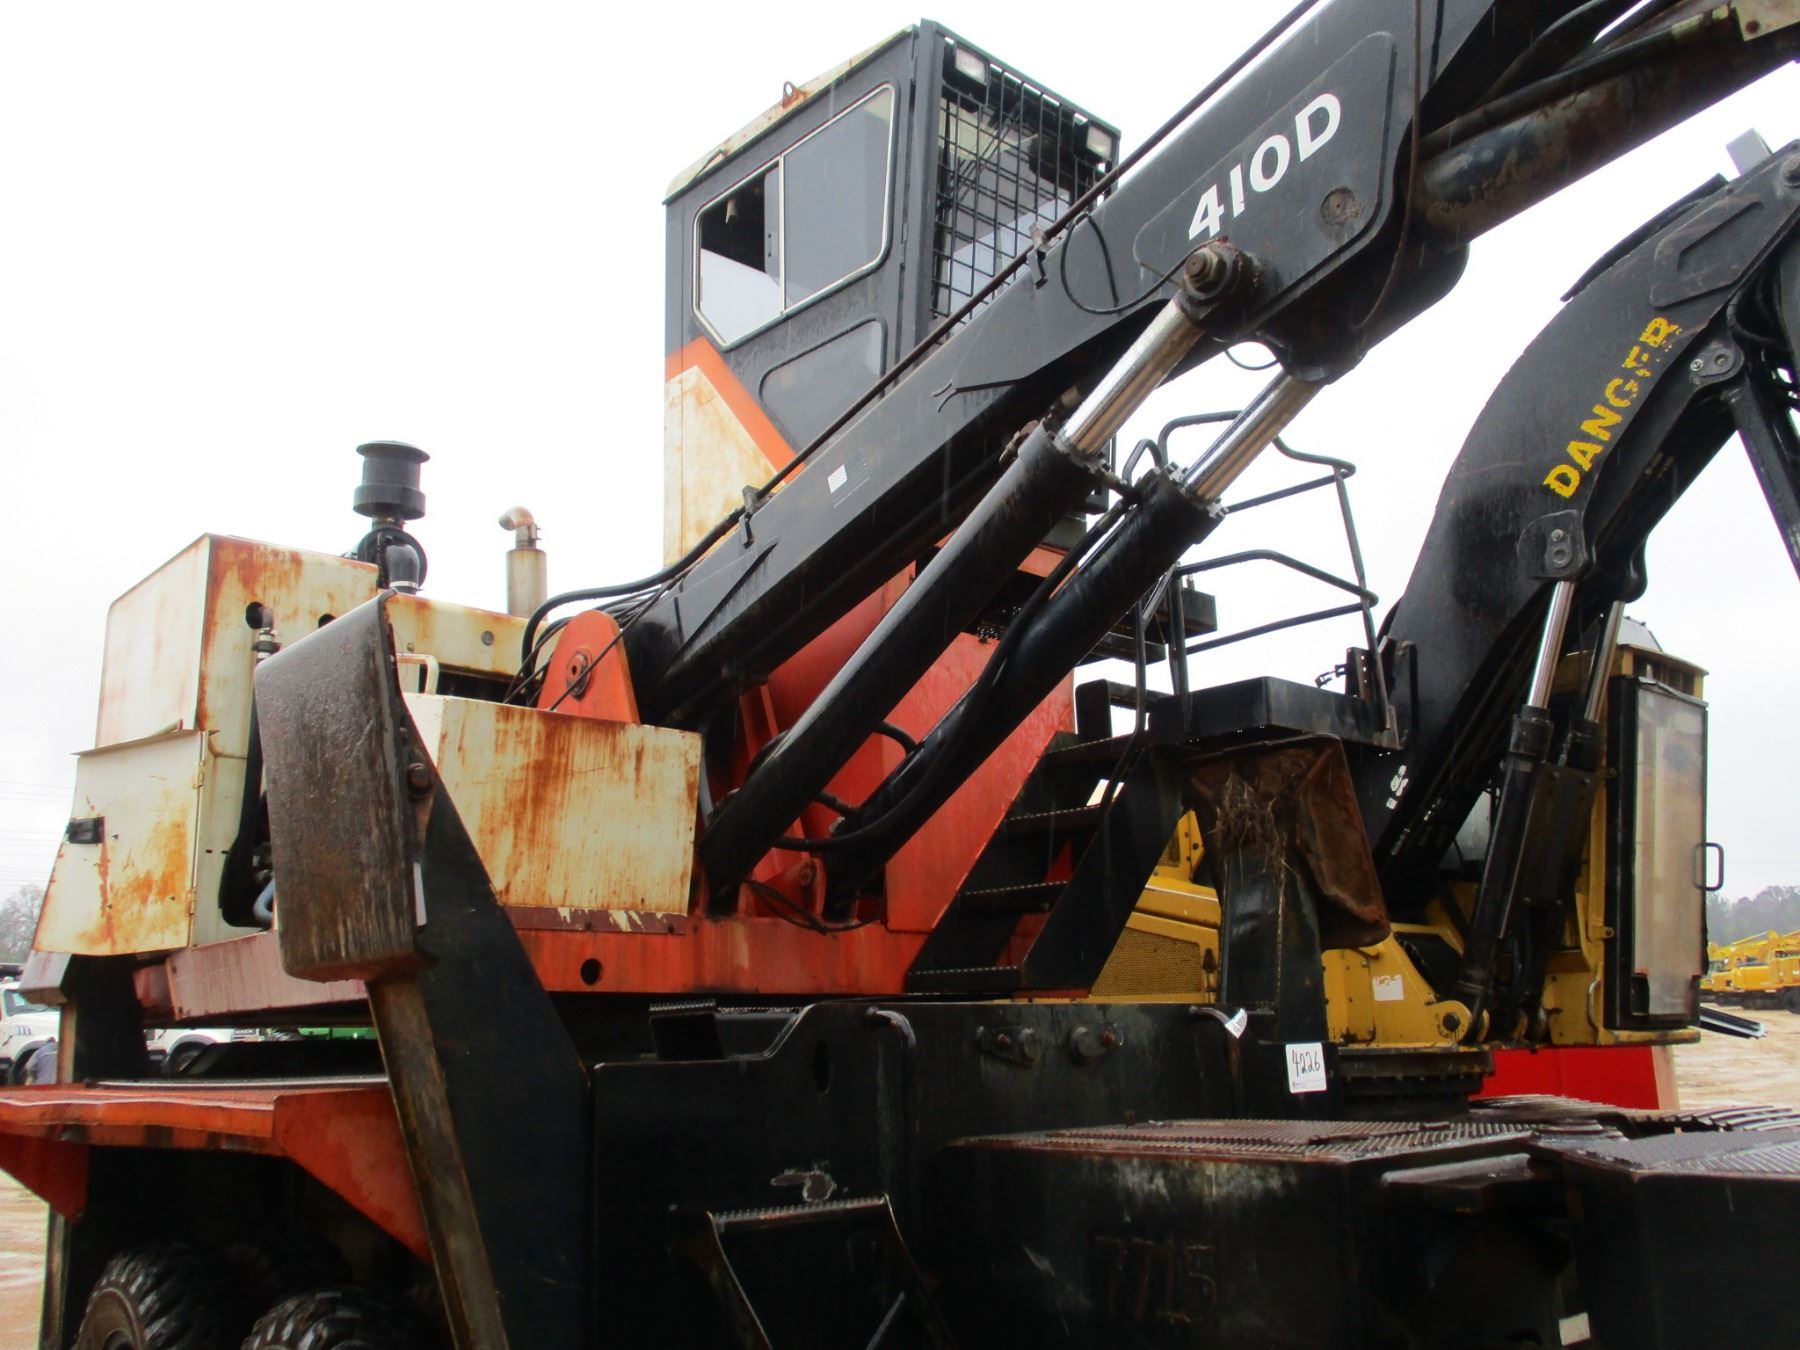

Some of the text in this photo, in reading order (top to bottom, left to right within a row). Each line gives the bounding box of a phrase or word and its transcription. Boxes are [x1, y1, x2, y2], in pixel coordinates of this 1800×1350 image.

[1188, 92, 1341, 241] 410D
[1543, 317, 1681, 498] DANGER
[1292, 1049, 1321, 1077] 4226
